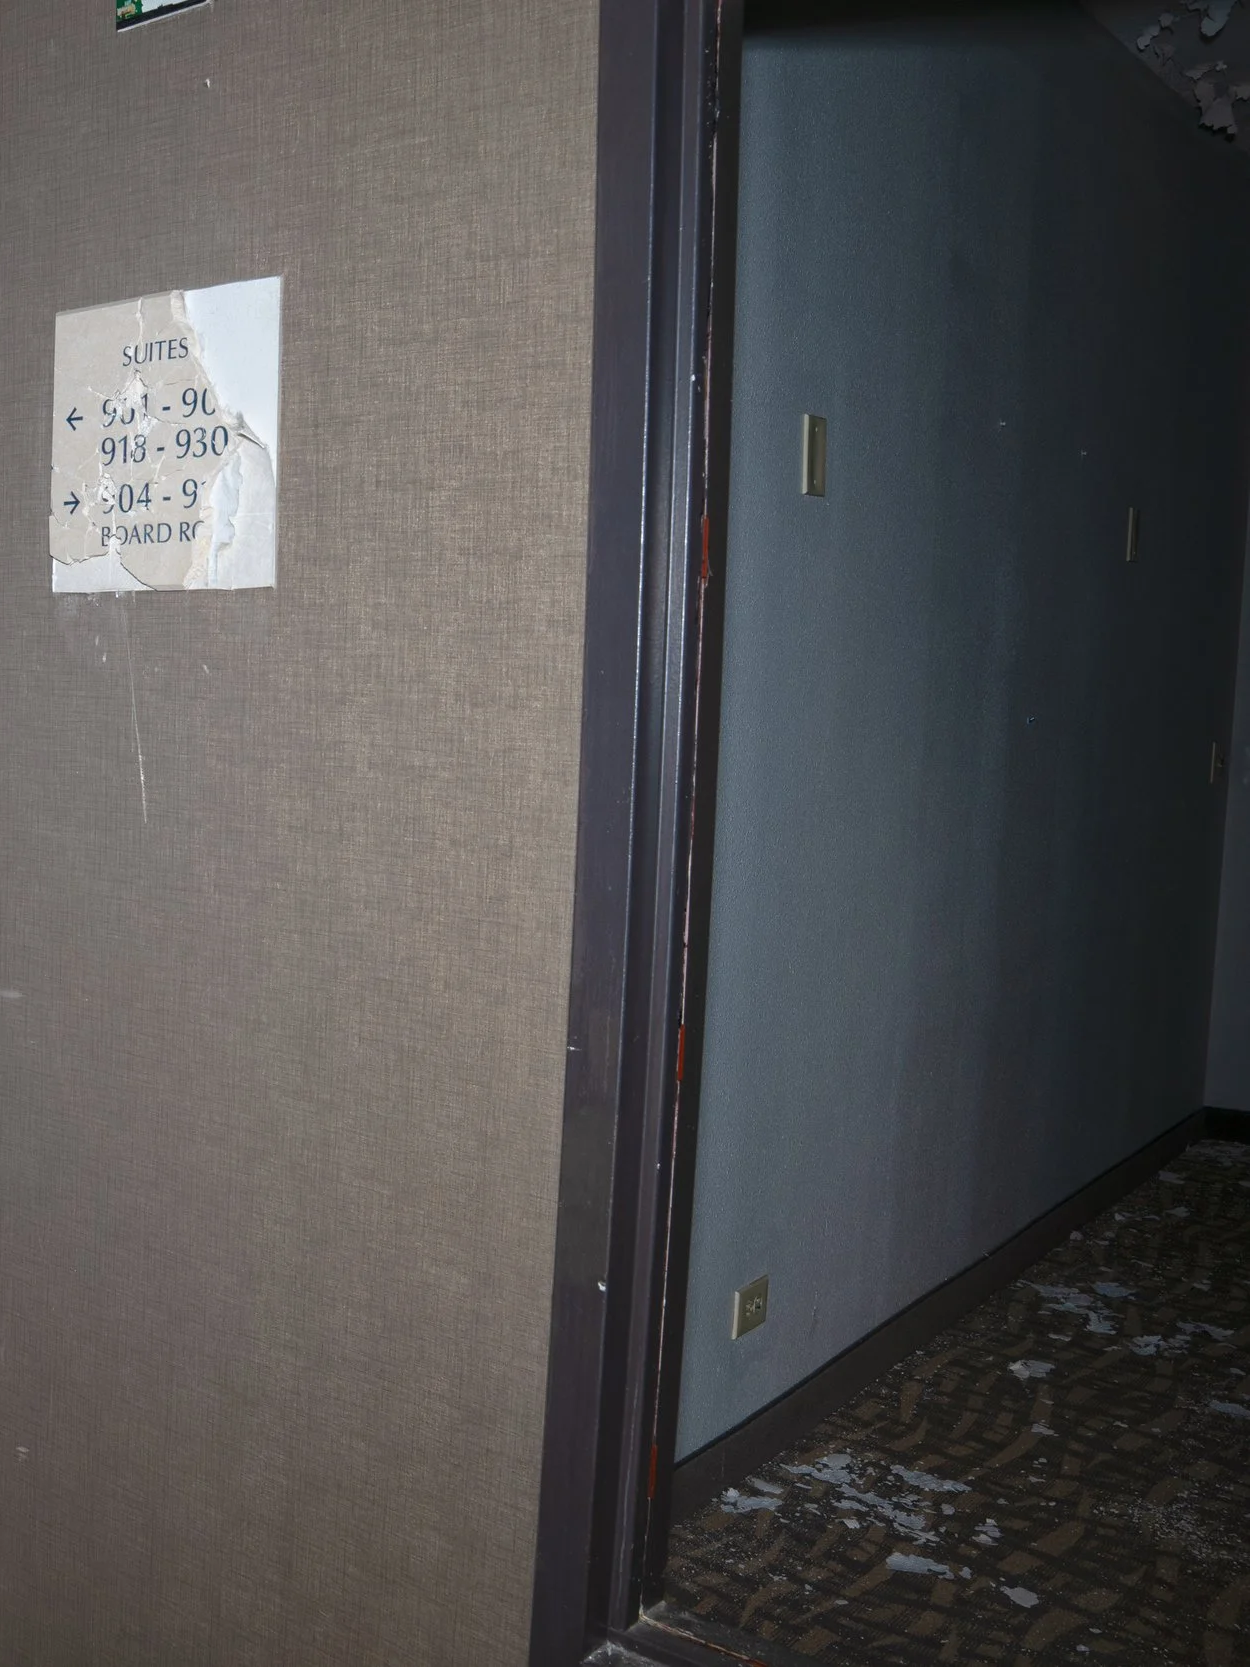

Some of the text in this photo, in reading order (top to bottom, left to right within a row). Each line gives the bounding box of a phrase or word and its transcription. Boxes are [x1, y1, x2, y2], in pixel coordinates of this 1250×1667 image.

[122, 337, 189, 367] SUITES
[101, 434, 147, 466] 918
[175, 425, 229, 459] 930
[101, 522, 172, 547] BOARD
